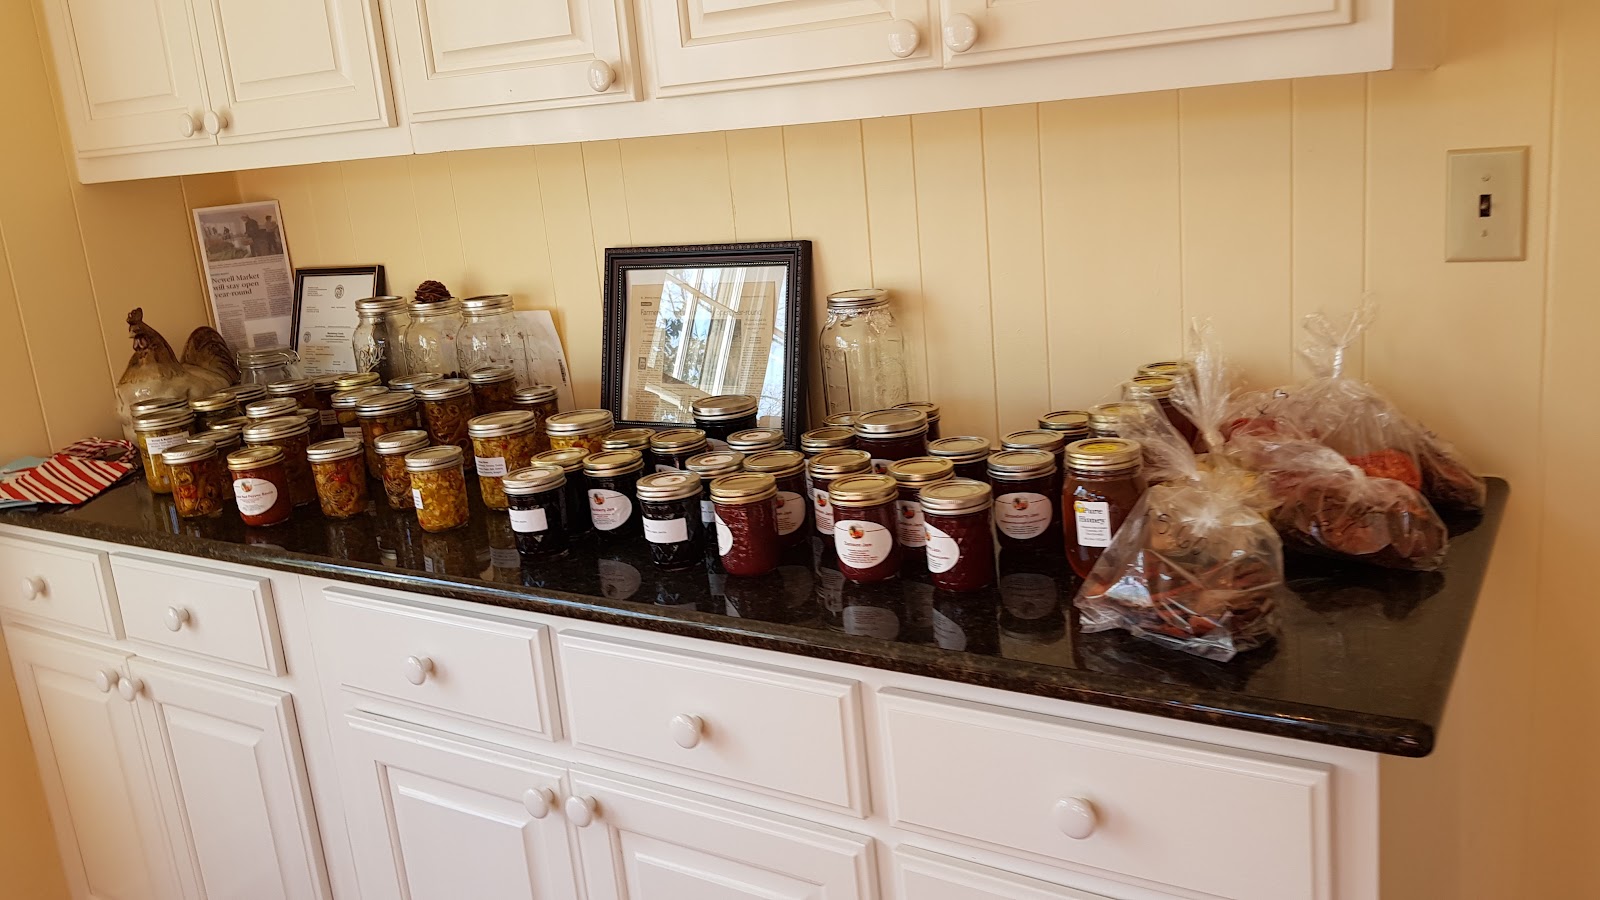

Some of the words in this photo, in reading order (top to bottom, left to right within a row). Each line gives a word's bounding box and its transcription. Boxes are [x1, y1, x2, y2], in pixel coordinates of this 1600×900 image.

[212, 275, 235, 284] Newell
[236, 273, 260, 281] Market
[226, 283, 240, 291] stay
[241, 281, 260, 289] open
[213, 289, 252, 299] year-round
[1078, 515, 1106, 525] Honey
